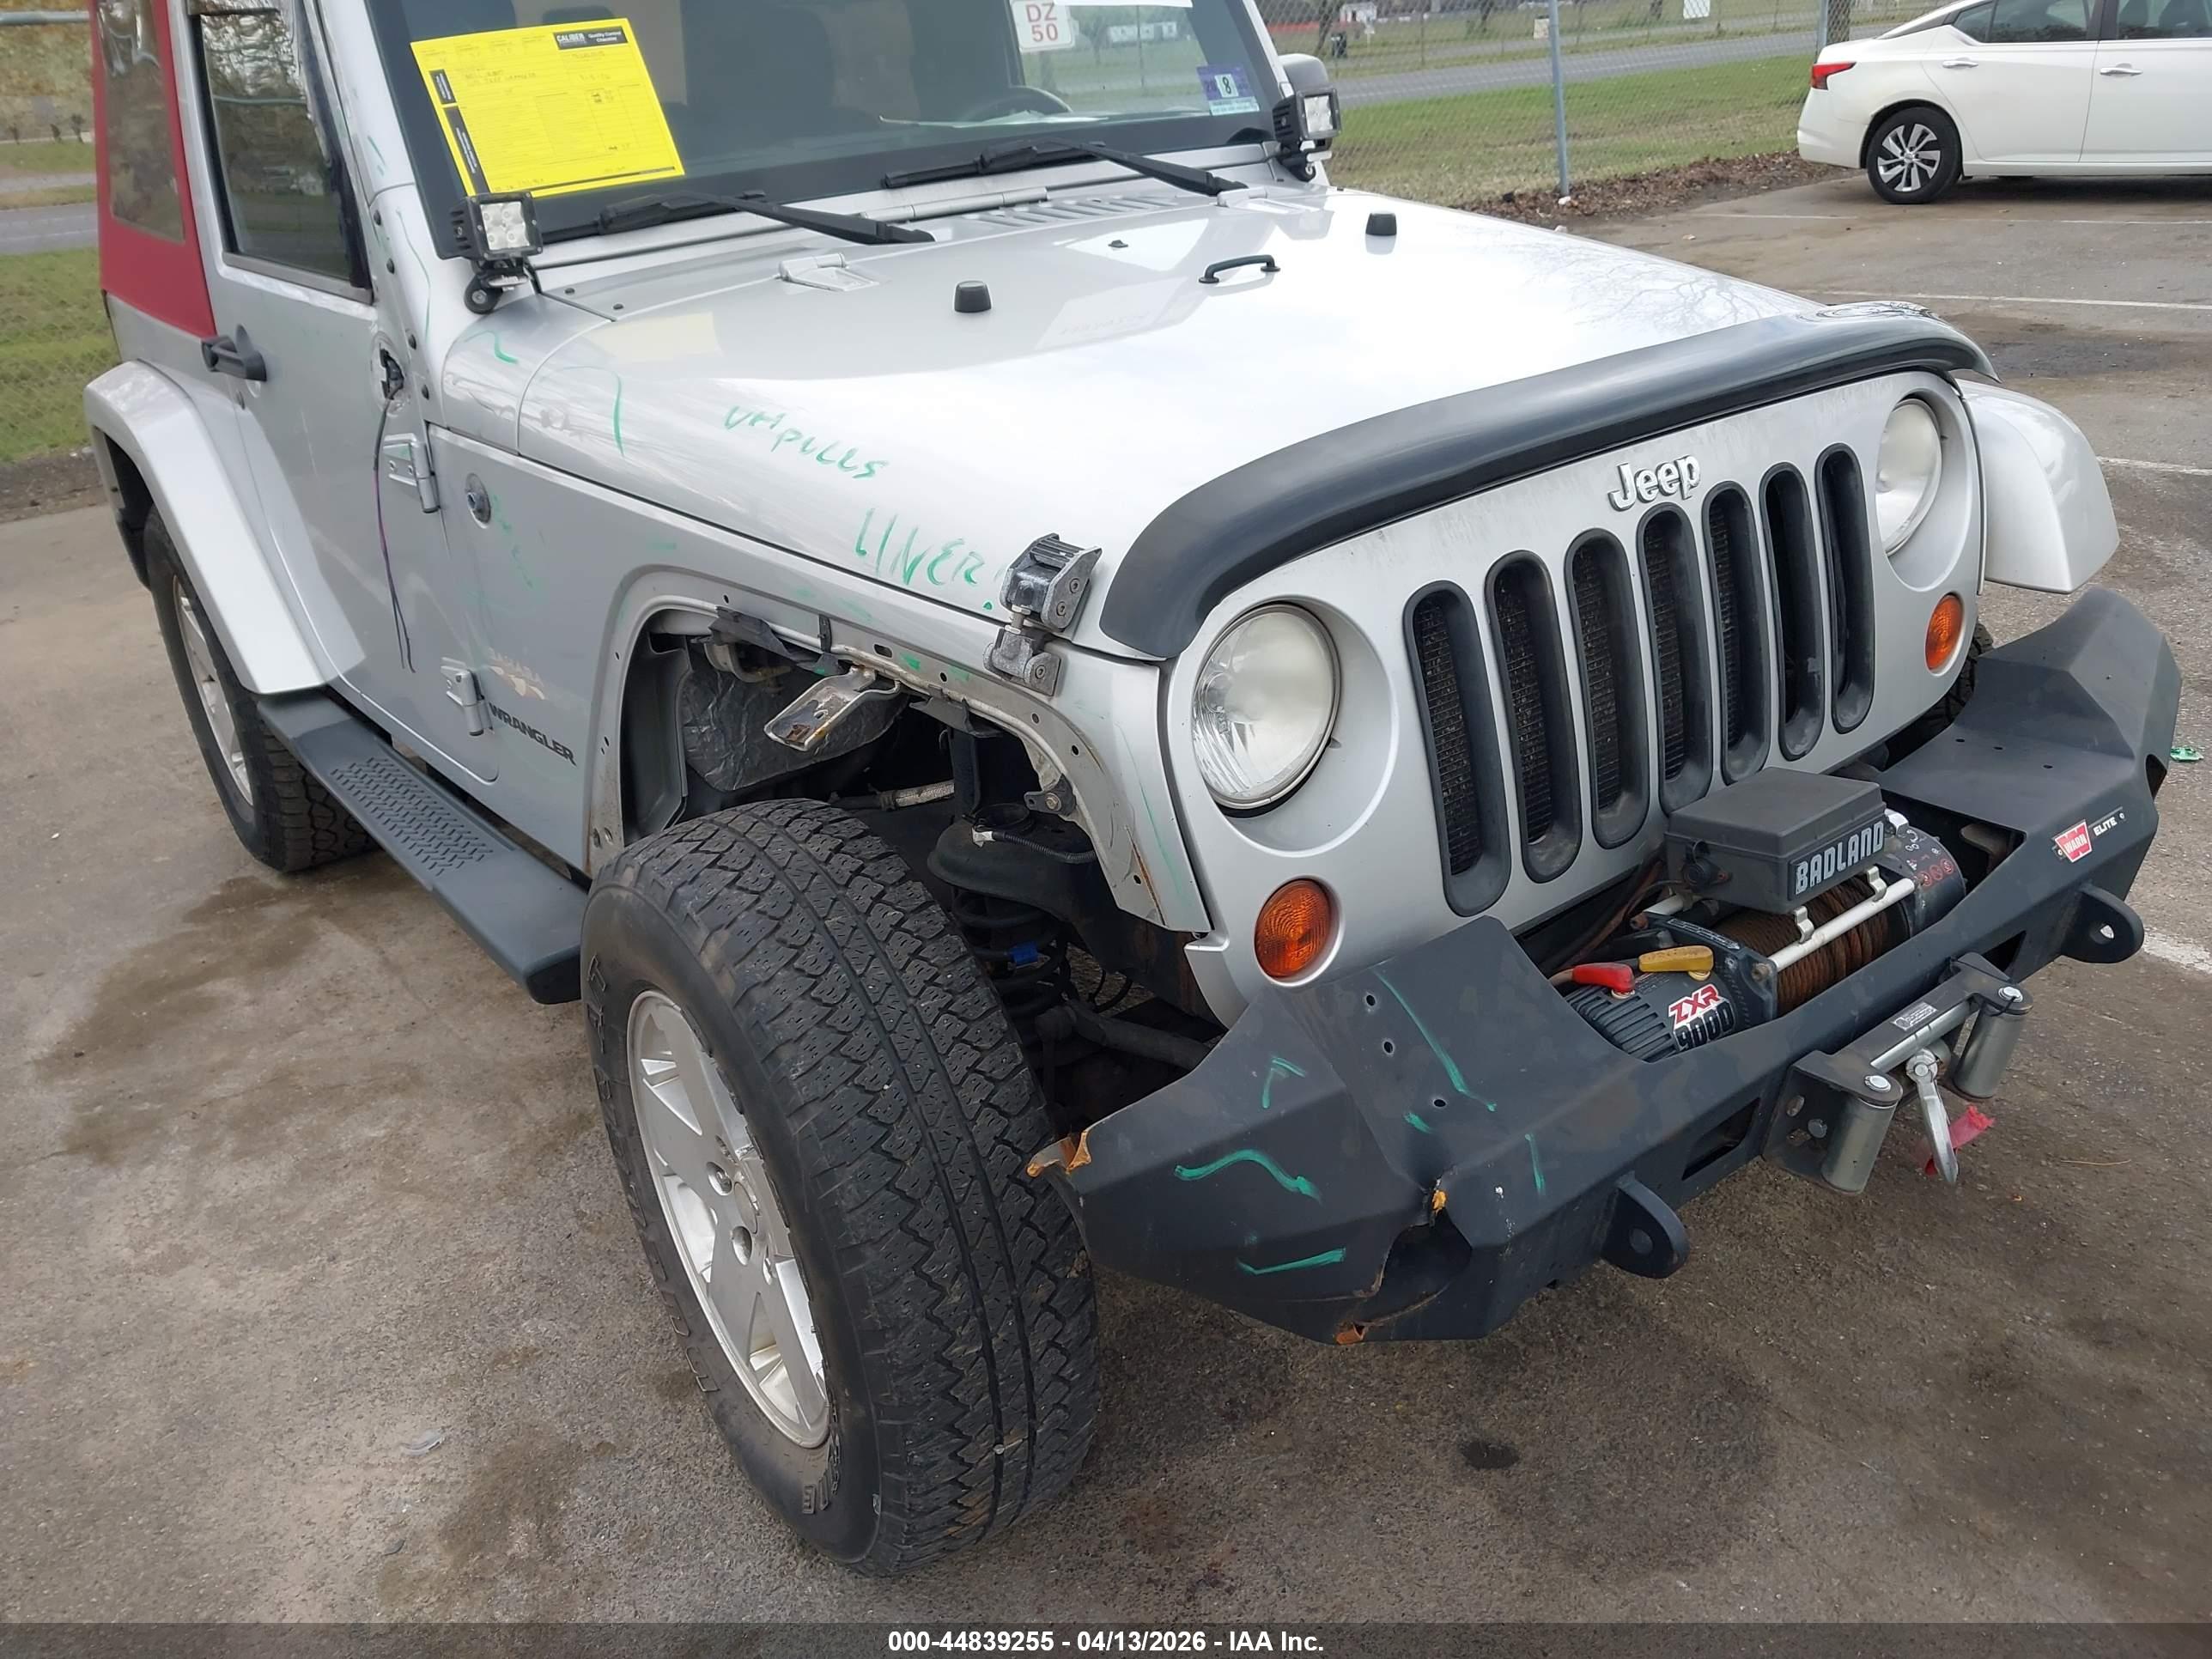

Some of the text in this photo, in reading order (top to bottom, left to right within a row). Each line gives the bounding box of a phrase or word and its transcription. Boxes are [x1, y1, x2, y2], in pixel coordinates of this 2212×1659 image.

[1025, 3, 1058, 23] DZ
[1031, 22, 1059, 42] 50
[1222, 76, 1231, 94] 8
[1607, 454, 1701, 512] Jeep
[488, 702, 578, 766] WRANGLER
[2063, 816, 2118, 854] WARN ELITE
[1795, 820, 1885, 896] BADLAND
[1668, 984, 1722, 1025] ZXR
[1674, 1001, 1736, 1051] 9000
